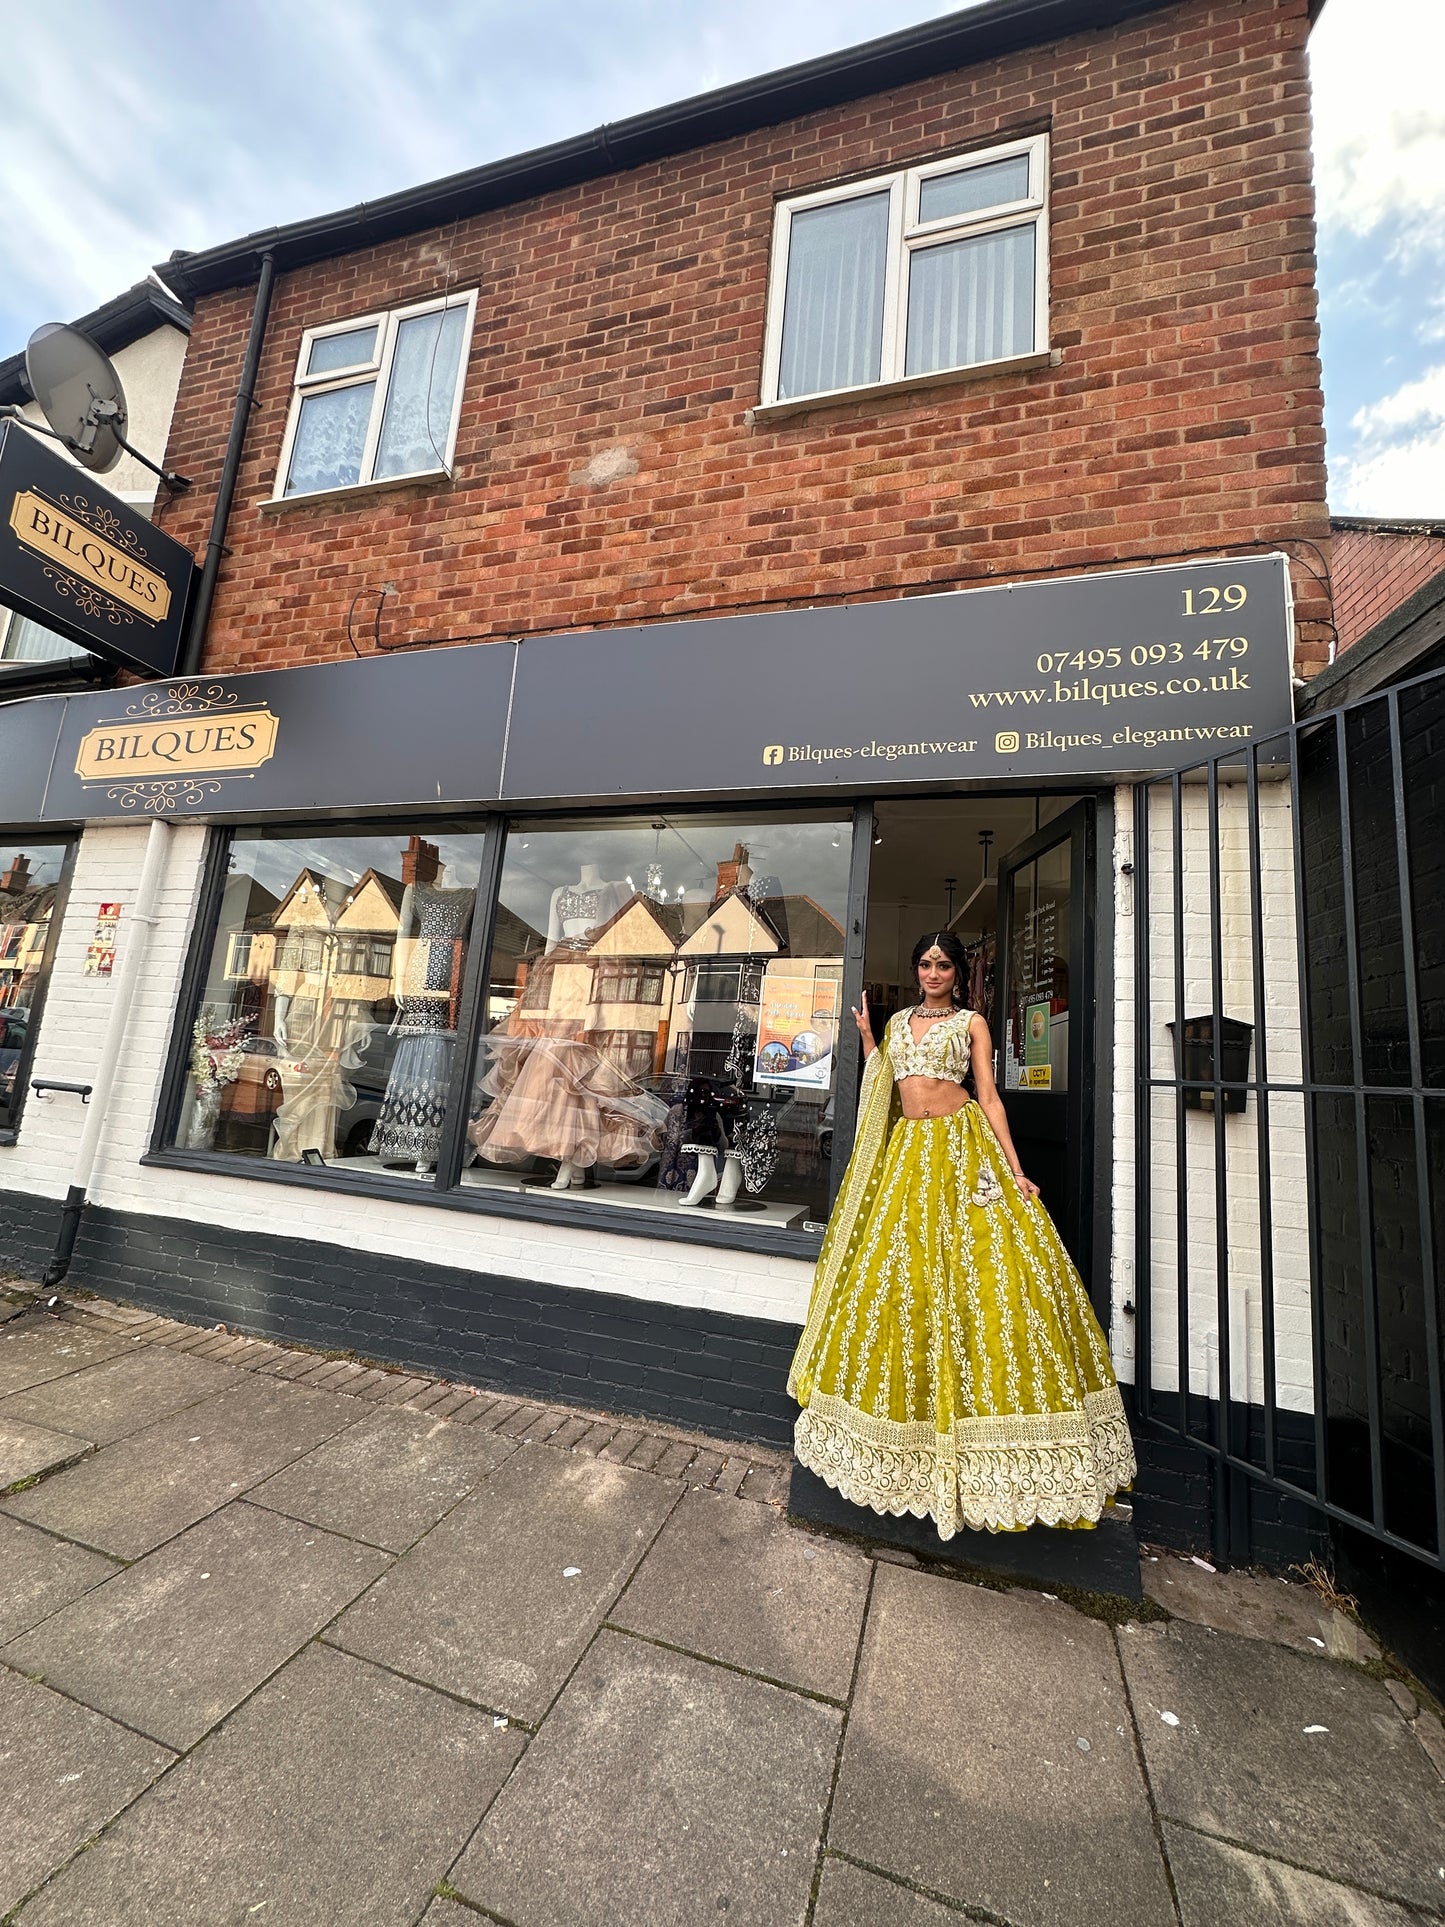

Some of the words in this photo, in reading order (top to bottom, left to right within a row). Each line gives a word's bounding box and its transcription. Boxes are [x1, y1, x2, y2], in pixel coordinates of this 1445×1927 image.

[30, 506, 159, 603] BILQUES
[1181, 584, 1248, 617] 129
[1036, 647, 1123, 673] 07495
[1130, 642, 1184, 666] 093
[1192, 636, 1249, 661] 479
[968, 666, 1252, 709] www.bilques.co.uk
[94, 724, 257, 762] BILQUES
[788, 740, 978, 765] Bilques-elegantwear
[1025, 724, 1253, 752] Bilques_elegantwear
[1033, 1068, 1047, 1078] CCTV
